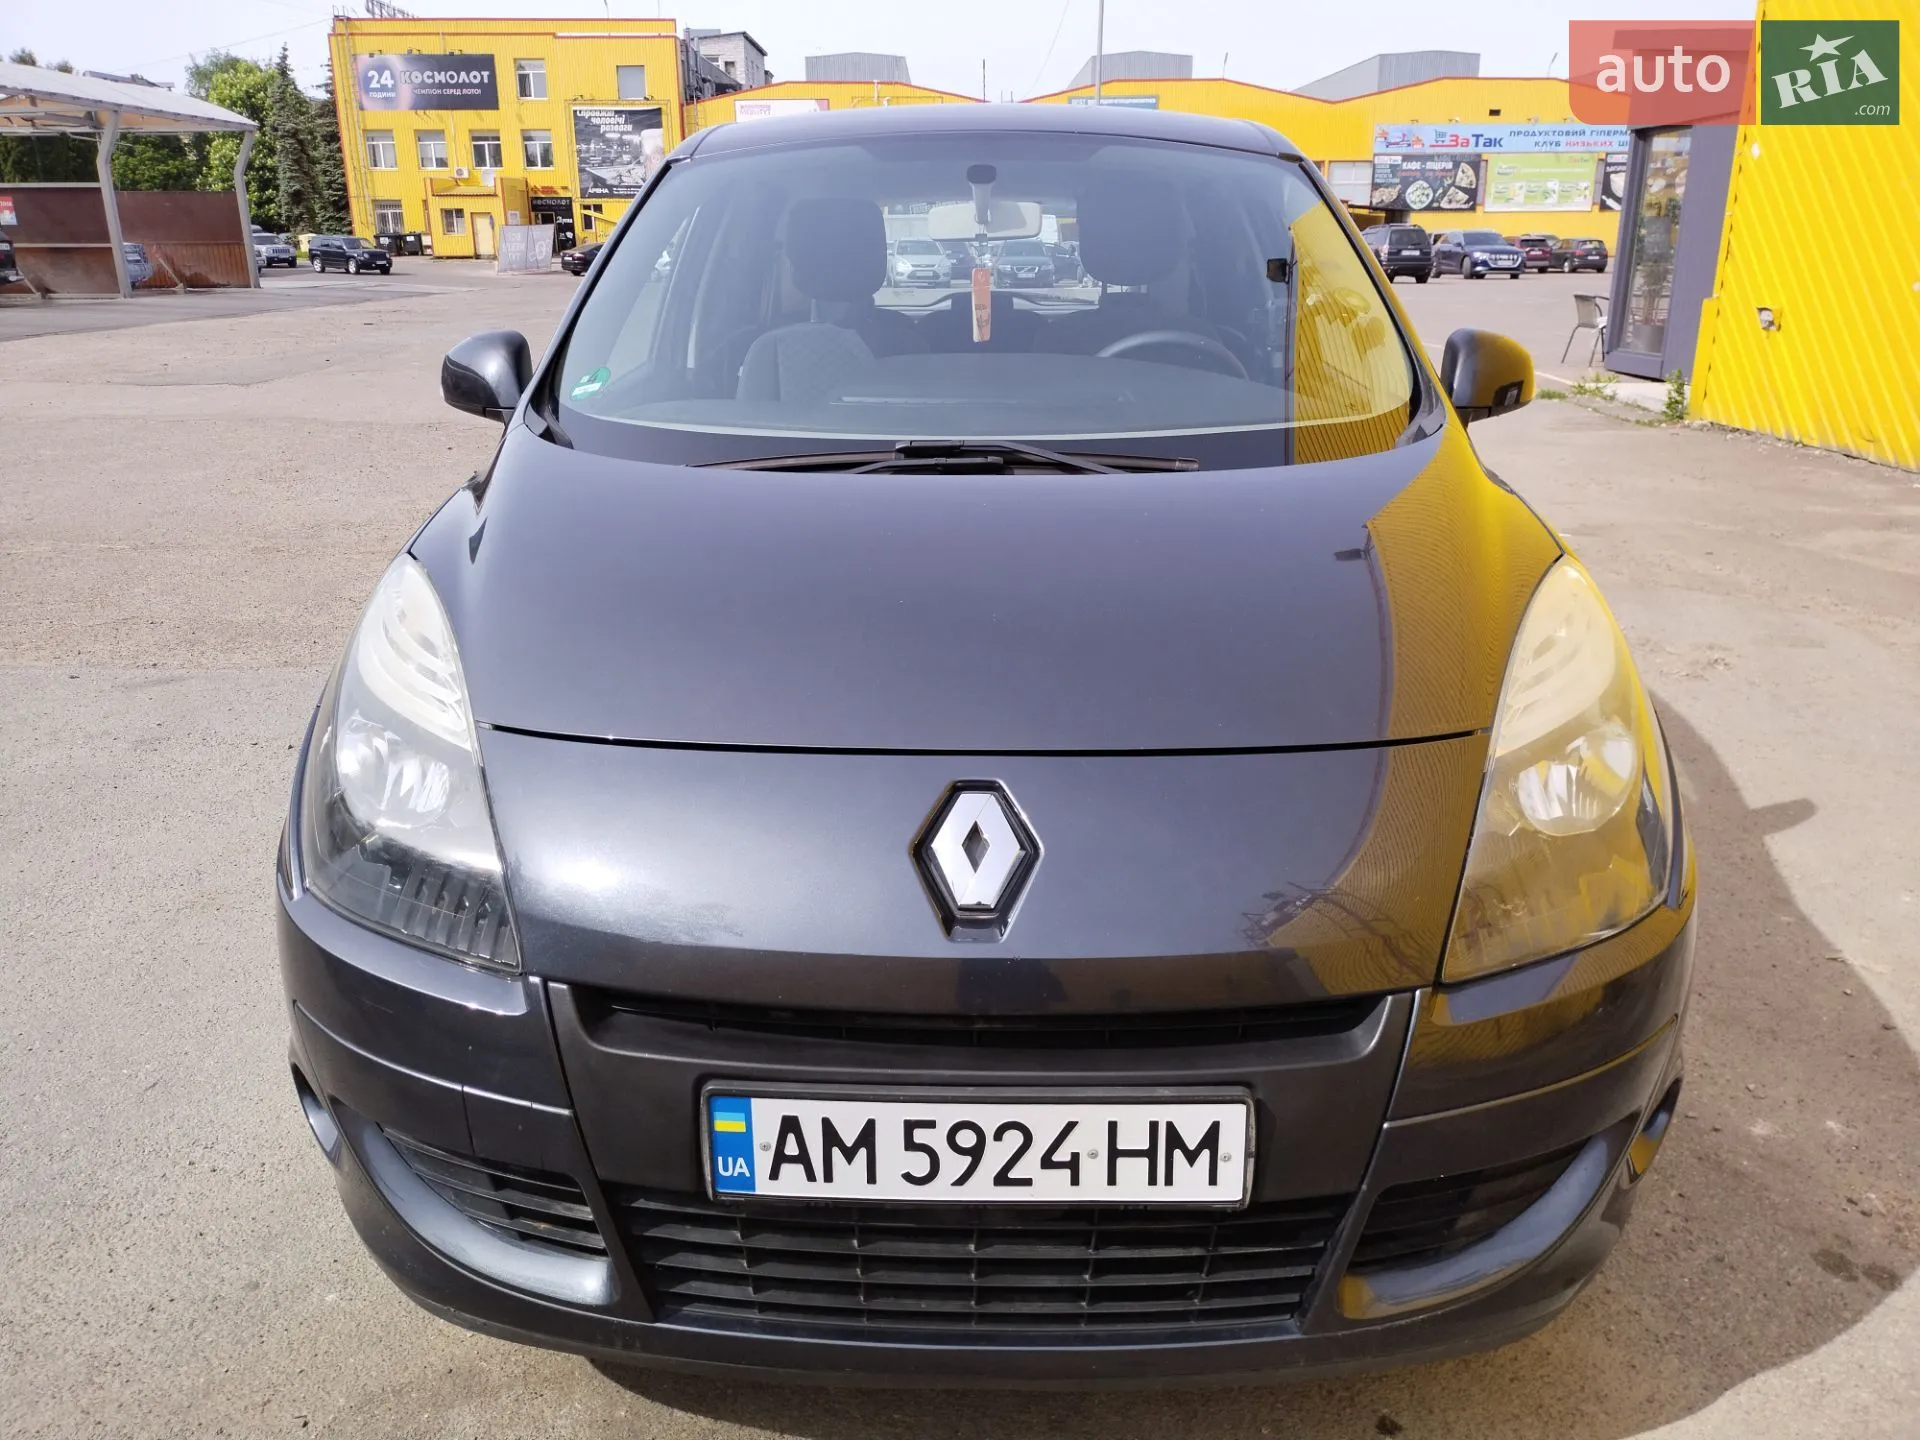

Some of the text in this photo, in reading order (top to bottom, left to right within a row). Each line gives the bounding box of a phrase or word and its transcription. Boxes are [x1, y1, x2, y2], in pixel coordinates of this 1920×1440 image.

[367, 70, 394, 88] 24
[399, 70, 490, 84] КОСМОЛОТ
[442, 88, 462, 96] СЕРЕД
[590, 114, 626, 125] чоловічі
[1509, 129, 1586, 137] ПРОДУКТОВИЙ
[1534, 140, 1562, 148] КЛУБ
[1565, 140, 1614, 148] НИЗЬКИХ
[768, 1114, 1220, 1187] AM 5924 HM
[717, 1156, 750, 1177] UA
